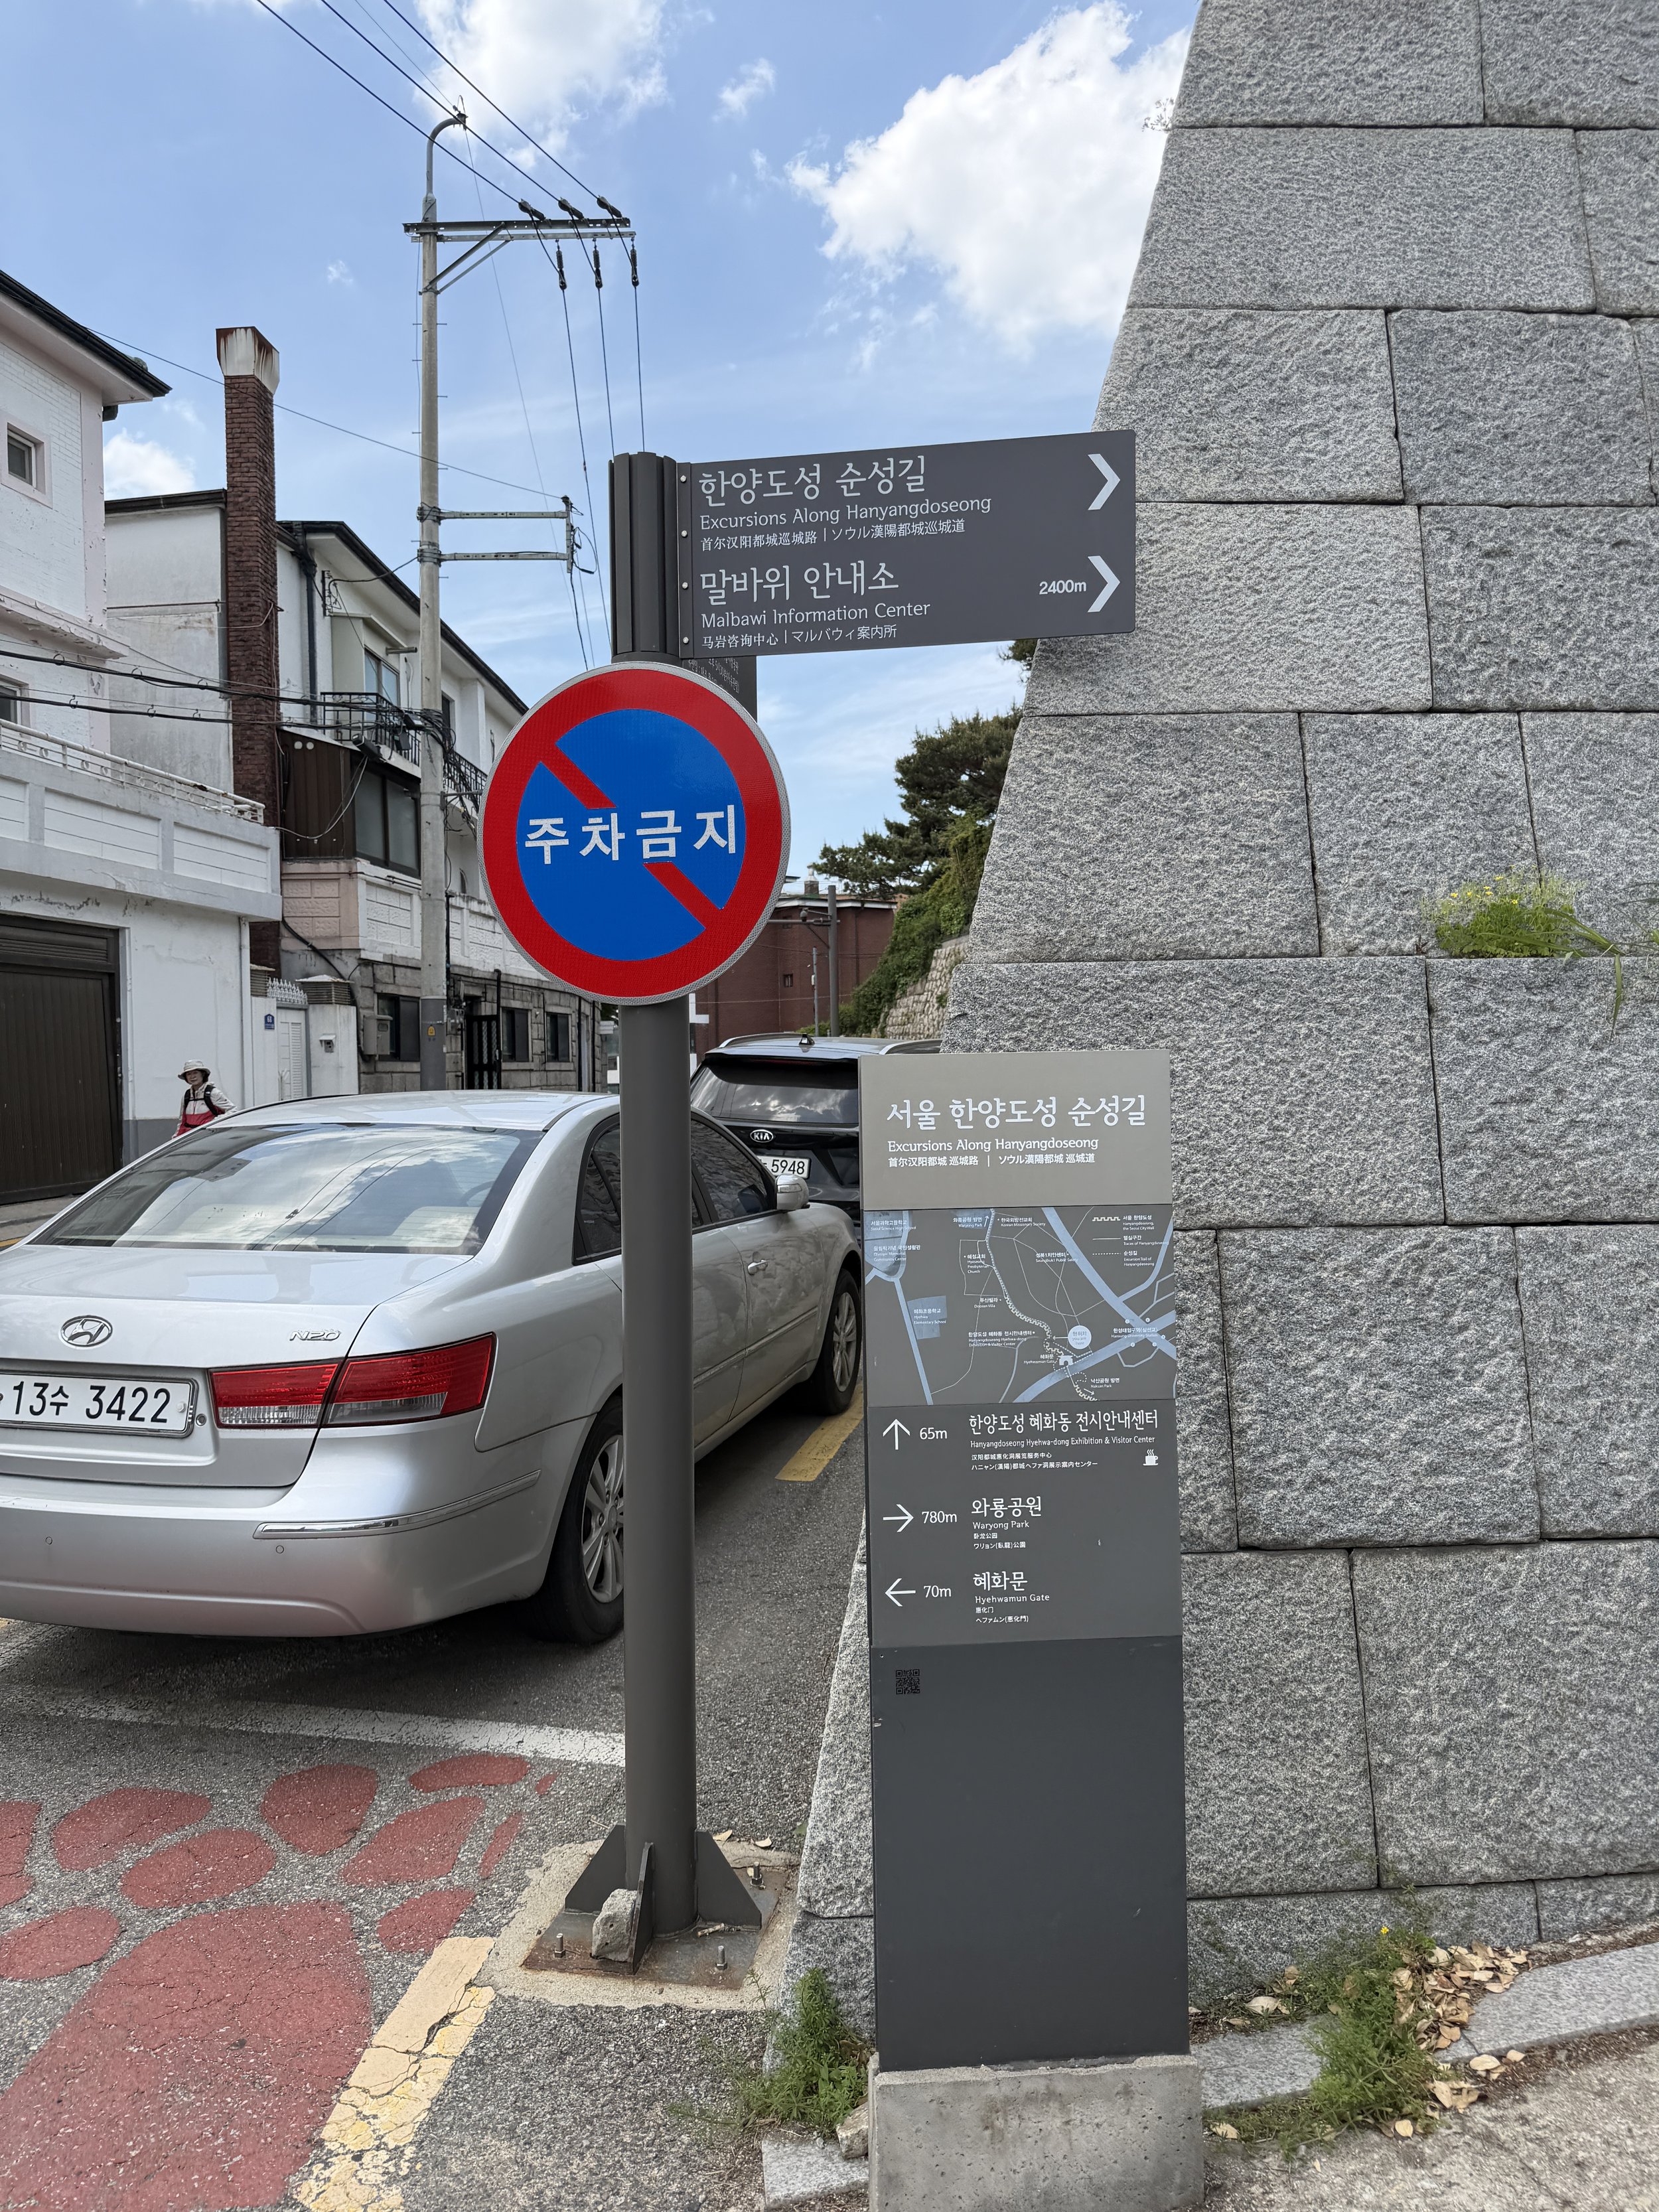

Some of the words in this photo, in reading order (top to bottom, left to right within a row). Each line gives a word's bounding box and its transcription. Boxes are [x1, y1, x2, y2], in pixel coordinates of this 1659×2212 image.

[698, 464, 822, 507] 한양도성
[835, 455, 926, 496] 순성길
[699, 511, 787, 530] Excursions
[792, 507, 840, 524] Along
[845, 494, 992, 522] Hanyangdoseong
[700, 530, 818, 552] 首尔汉阳都城巡城路
[830, 518, 966, 541] ソウル漢陽都城巡城道
[699, 565, 790, 606] 말바위
[804, 560, 899, 599] 안내소
[1039, 579, 1087, 595] 2400m
[701, 610, 766, 628] Malbawi
[772, 605, 868, 625] Information
[875, 603, 931, 618] Center
[702, 632, 778, 649] 马岩咨询中心
[791, 624, 897, 642] マルバウィ案内所
[525, 804, 736, 865] 주차금지
[887, 1099, 941, 1130] 서울
[949, 1096, 1056, 1129] 한양도성
[1068, 1094, 1145, 1127] 순성길
[887, 1140, 953, 1152] Excursions
[956, 1139, 992, 1152] Along
[994, 1137, 1099, 1151] Hanyangdoseong
[771, 1159, 805, 1175] 5948
[13, 1380, 69, 1416] 13수
[86, 1384, 171, 1424] 3422
[968, 1413, 1024, 1435] 한양도성
[1029, 1412, 1072, 1432] 혜화동
[1076, 1409, 1158, 1432] 전시안내센터
[919, 1427, 948, 1440] 65m
[970, 1439, 1025, 1449] Hanyangdoseong
[1026, 1438, 1070, 1447] Hyehwa-dong
[921, 1511, 958, 1524] 780m
[971, 1496, 1042, 1518] 와룡공원
[972, 1522, 1009, 1530] Waryong
[1011, 1520, 1030, 1528] Park
[923, 1585, 952, 1598] 70m
[972, 1570, 1028, 1591] 혜화문
[975, 1595, 1027, 1605] Hyehwamun
